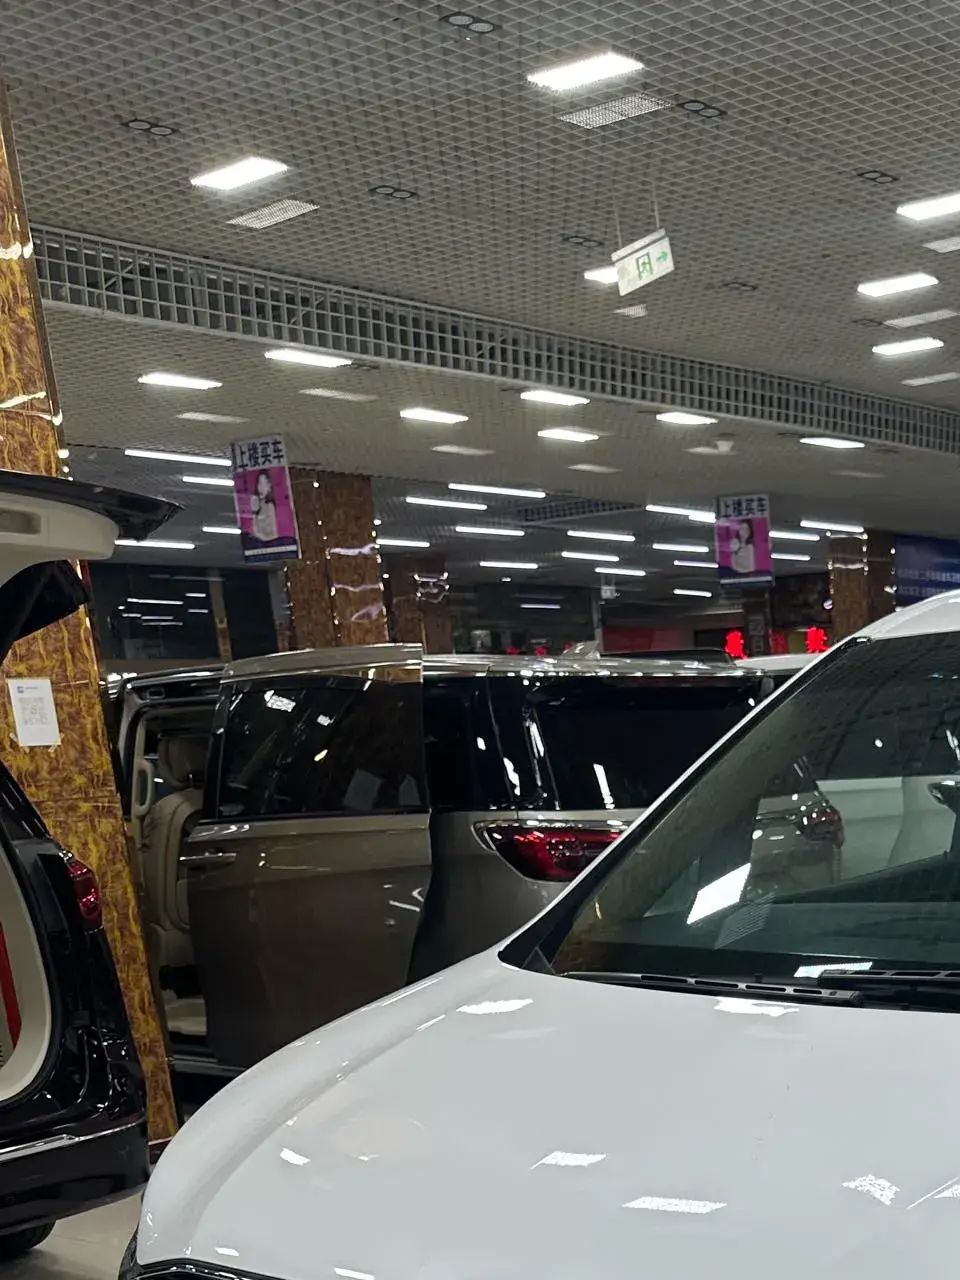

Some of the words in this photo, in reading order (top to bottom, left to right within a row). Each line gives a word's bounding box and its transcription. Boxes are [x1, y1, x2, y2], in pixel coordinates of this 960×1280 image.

[239, 439, 283, 468] 上楼买车
[720, 497, 766, 518] 上楼买车
